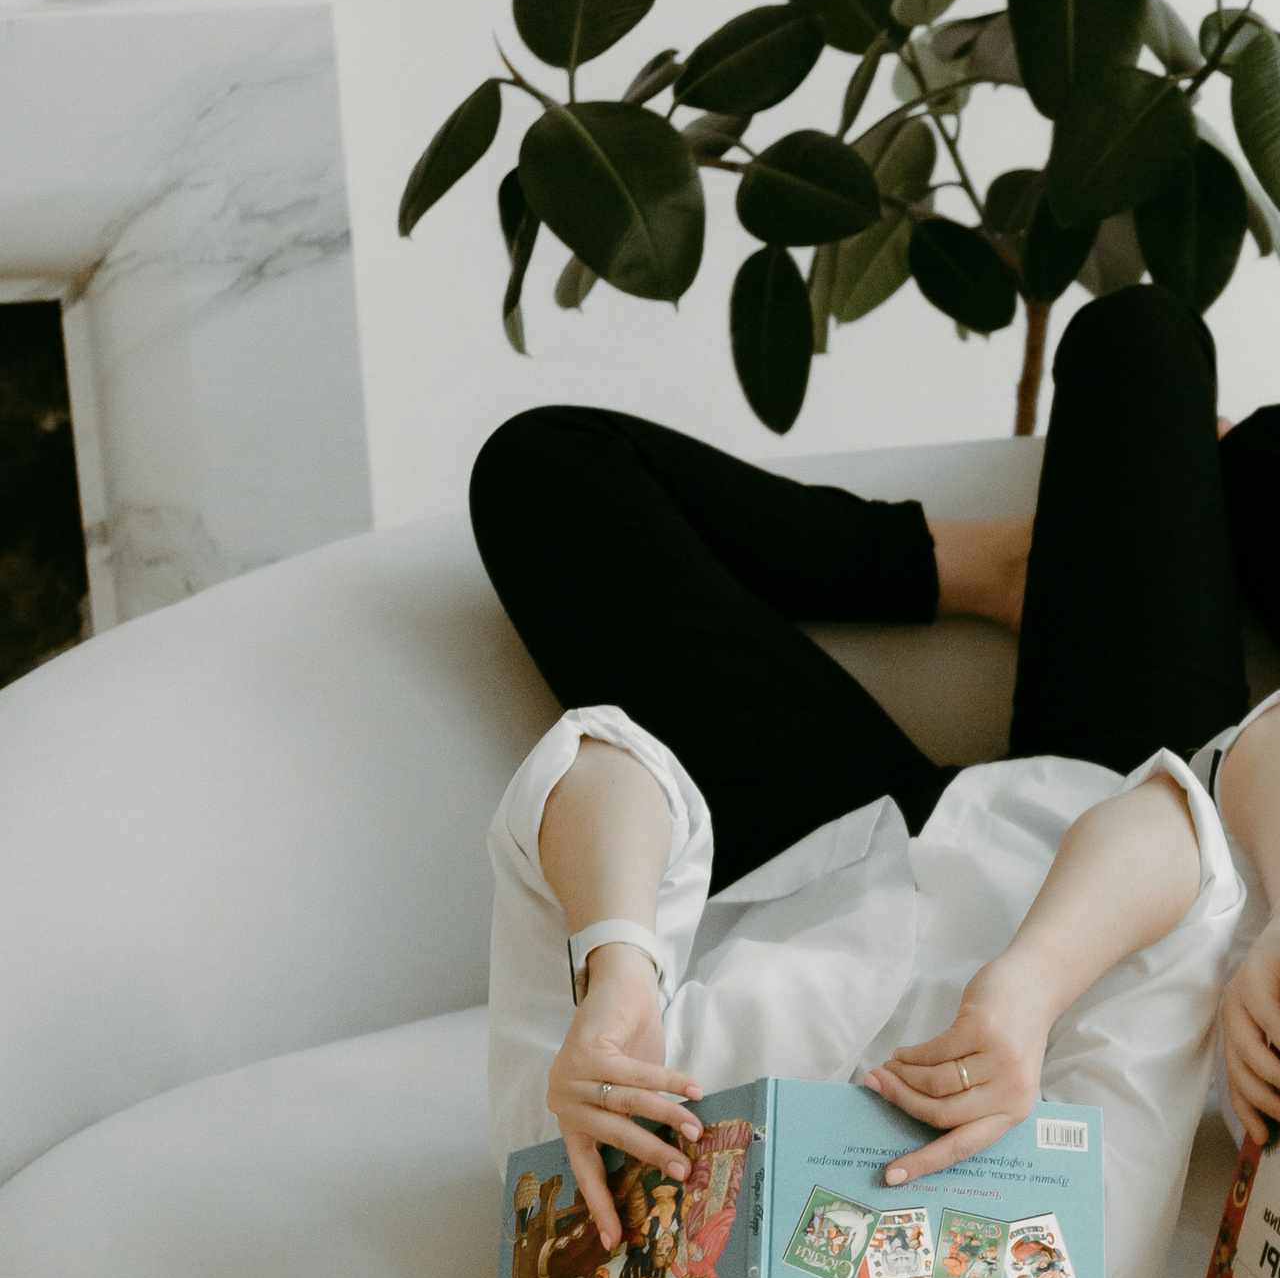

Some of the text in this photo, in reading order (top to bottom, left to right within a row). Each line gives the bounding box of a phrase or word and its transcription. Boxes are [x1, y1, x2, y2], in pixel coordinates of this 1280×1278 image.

[807, 1155, 854, 1166] авторов
[1026, 1161, 1033, 1170] в
[946, 1166, 986, 1178] лучшие
[988, 1169, 1026, 1182] сказки,
[1029, 1174, 1070, 1188] Лучшие
[912, 1184, 940, 1194] этой
[942, 1186, 948, 1194] в
[952, 1186, 1002, 1200] Читайте
